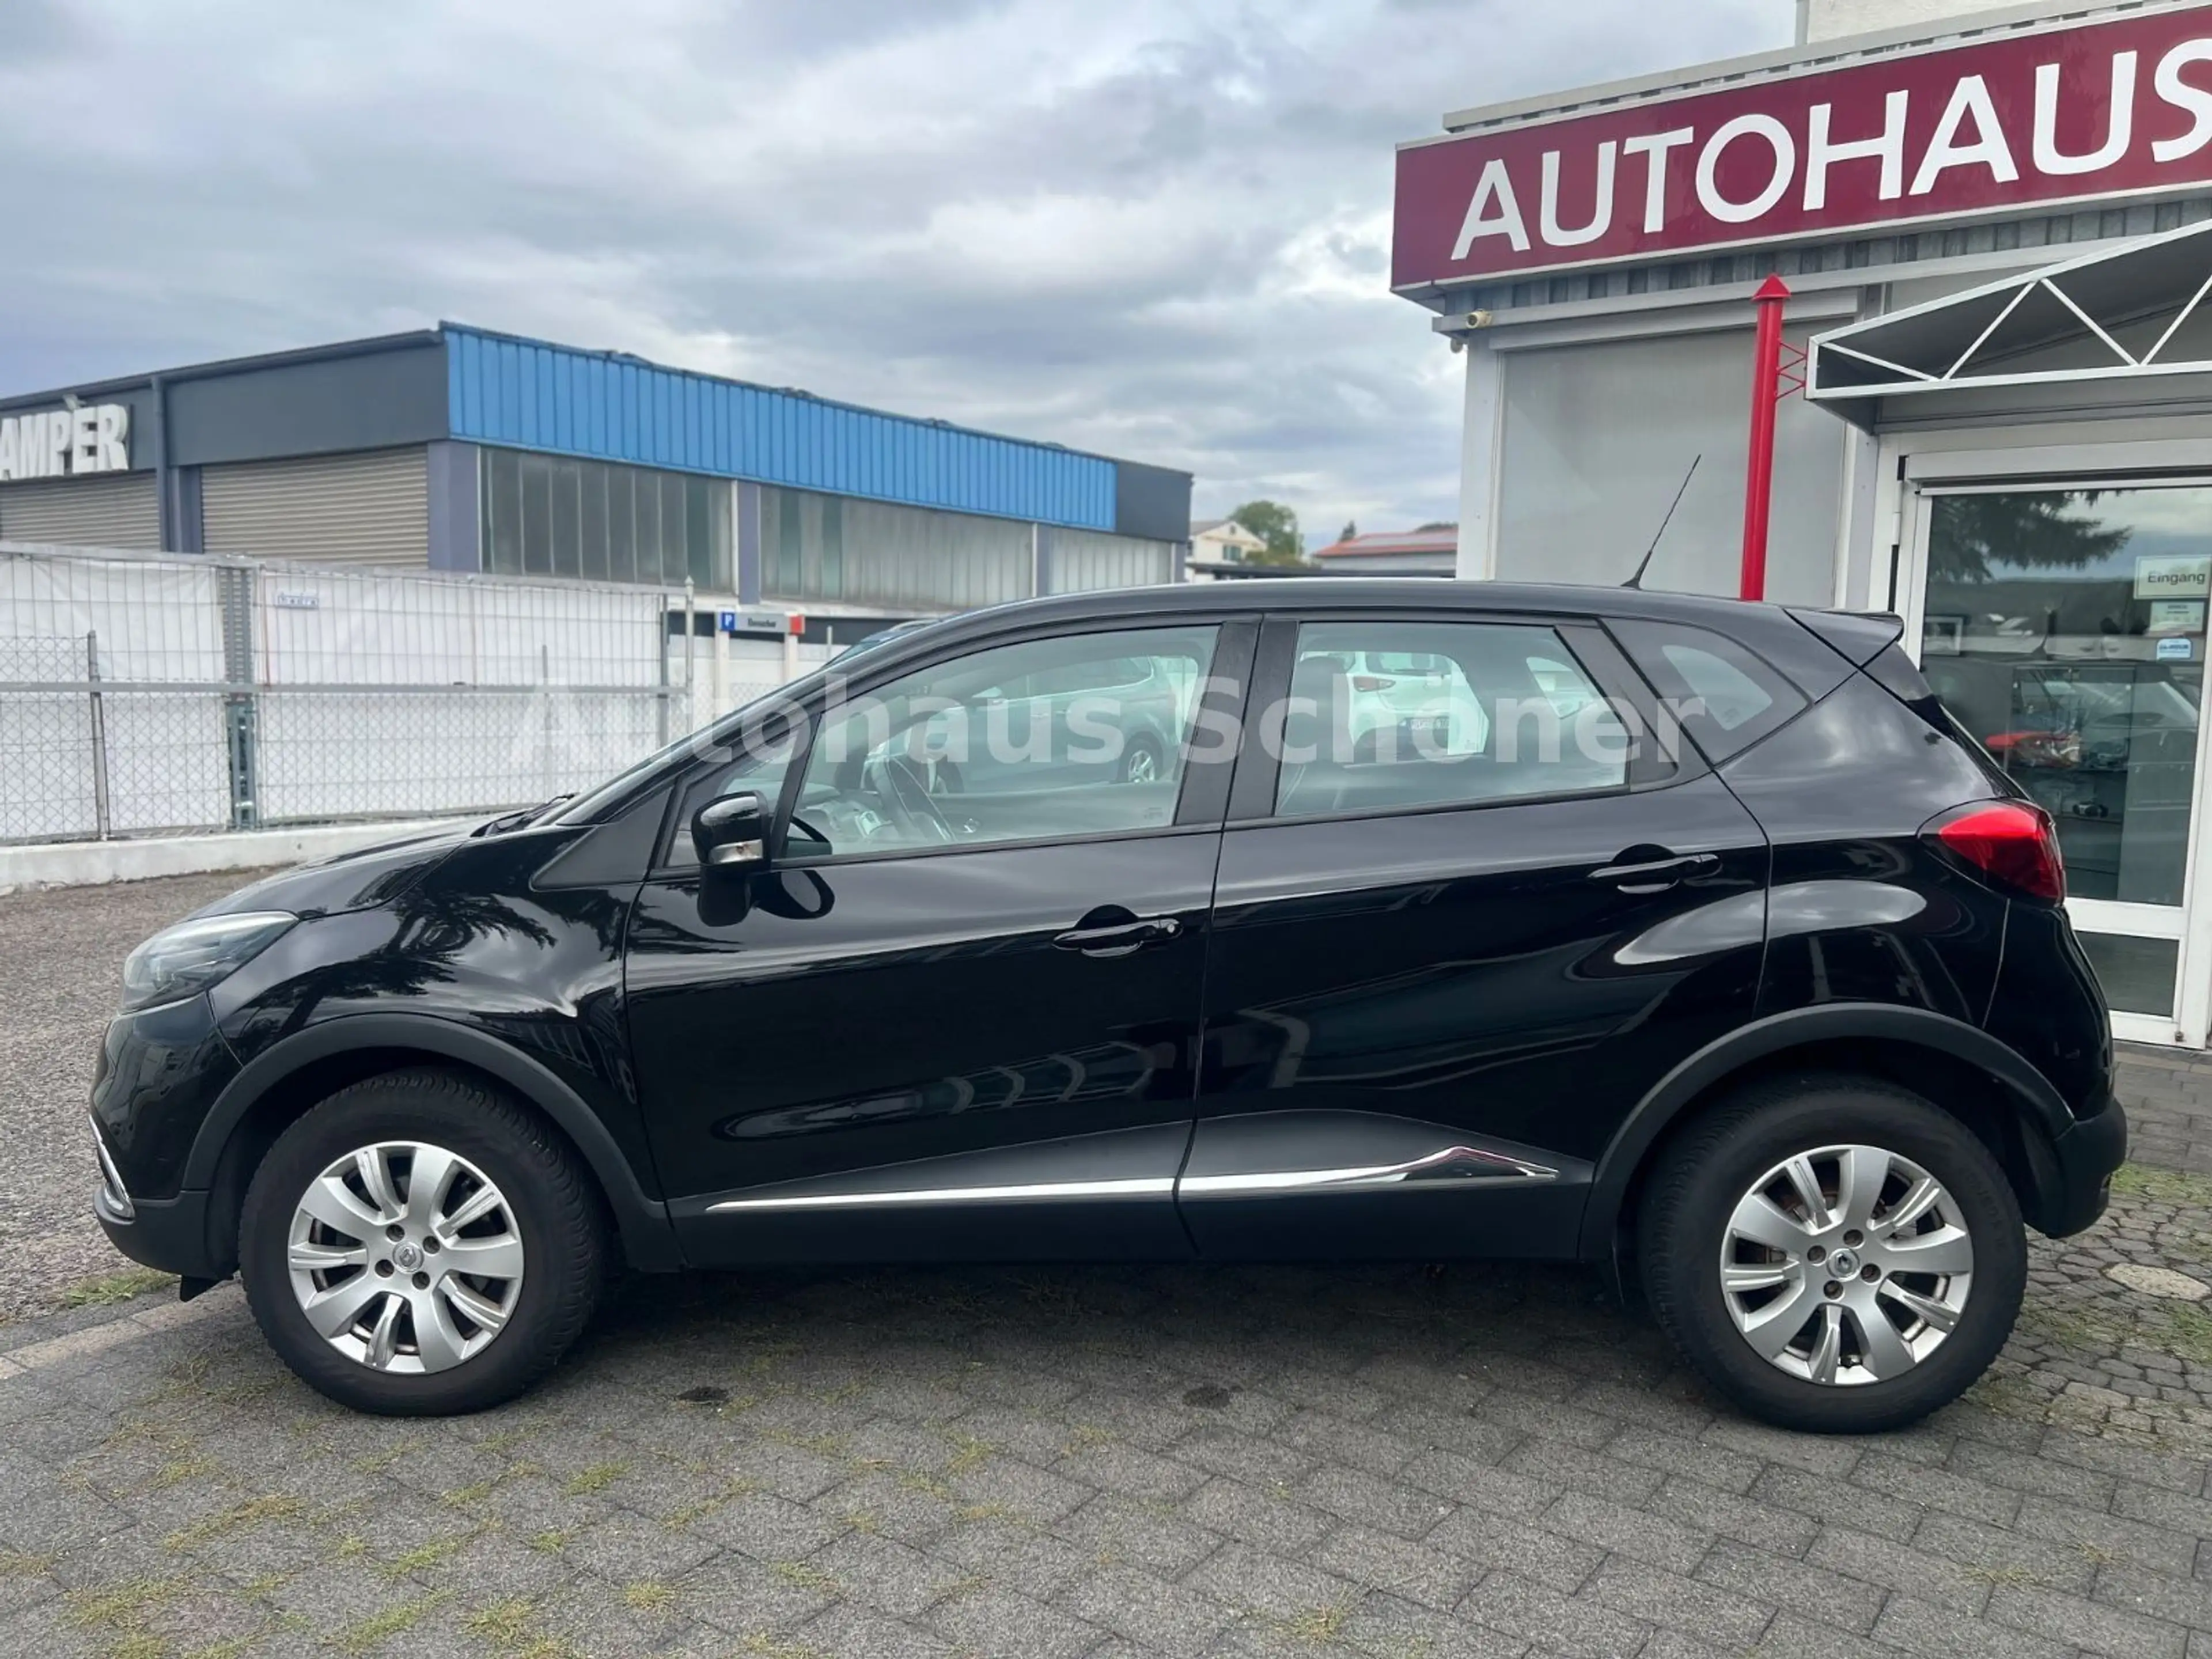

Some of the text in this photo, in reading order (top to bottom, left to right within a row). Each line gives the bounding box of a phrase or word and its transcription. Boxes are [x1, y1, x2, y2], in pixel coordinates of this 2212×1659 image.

[1451, 38, 2212, 261] AUTOHAUS
[2147, 573, 2205, 585] Eingang
[725, 614, 732, 627] P
